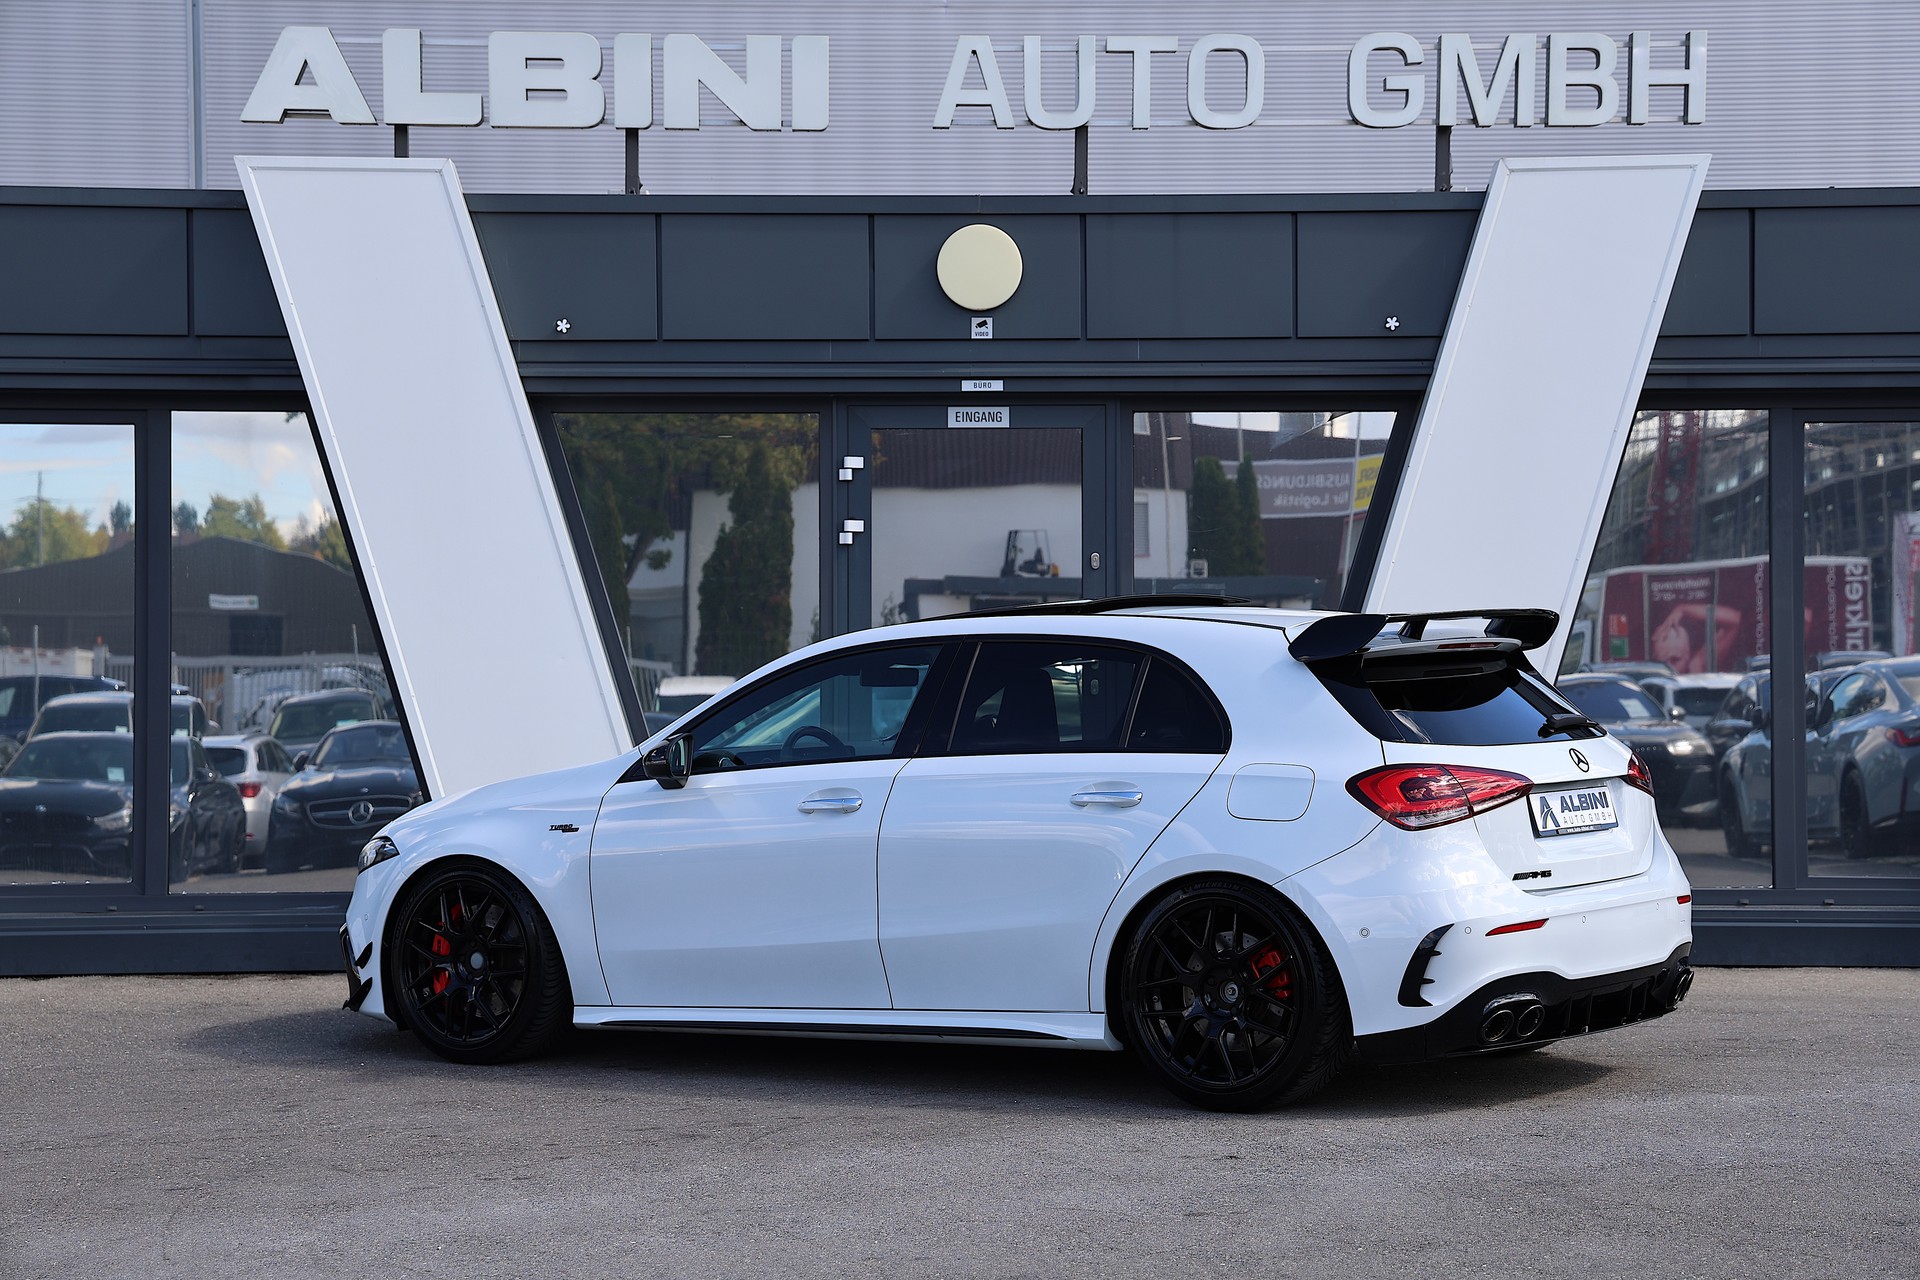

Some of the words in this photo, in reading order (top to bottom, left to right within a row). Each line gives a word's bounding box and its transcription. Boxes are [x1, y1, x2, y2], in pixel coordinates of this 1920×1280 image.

[240, 26, 830, 132] ALBINI
[932, 33, 1265, 130] AUTO
[1347, 29, 1709, 128] GMBH
[973, 381, 992, 389] BÜRO
[955, 411, 1003, 423] EINGANG
[1560, 791, 1610, 814] ALBINI
[1563, 814, 1586, 825] AUTO
[1588, 811, 1613, 823] GMBH
